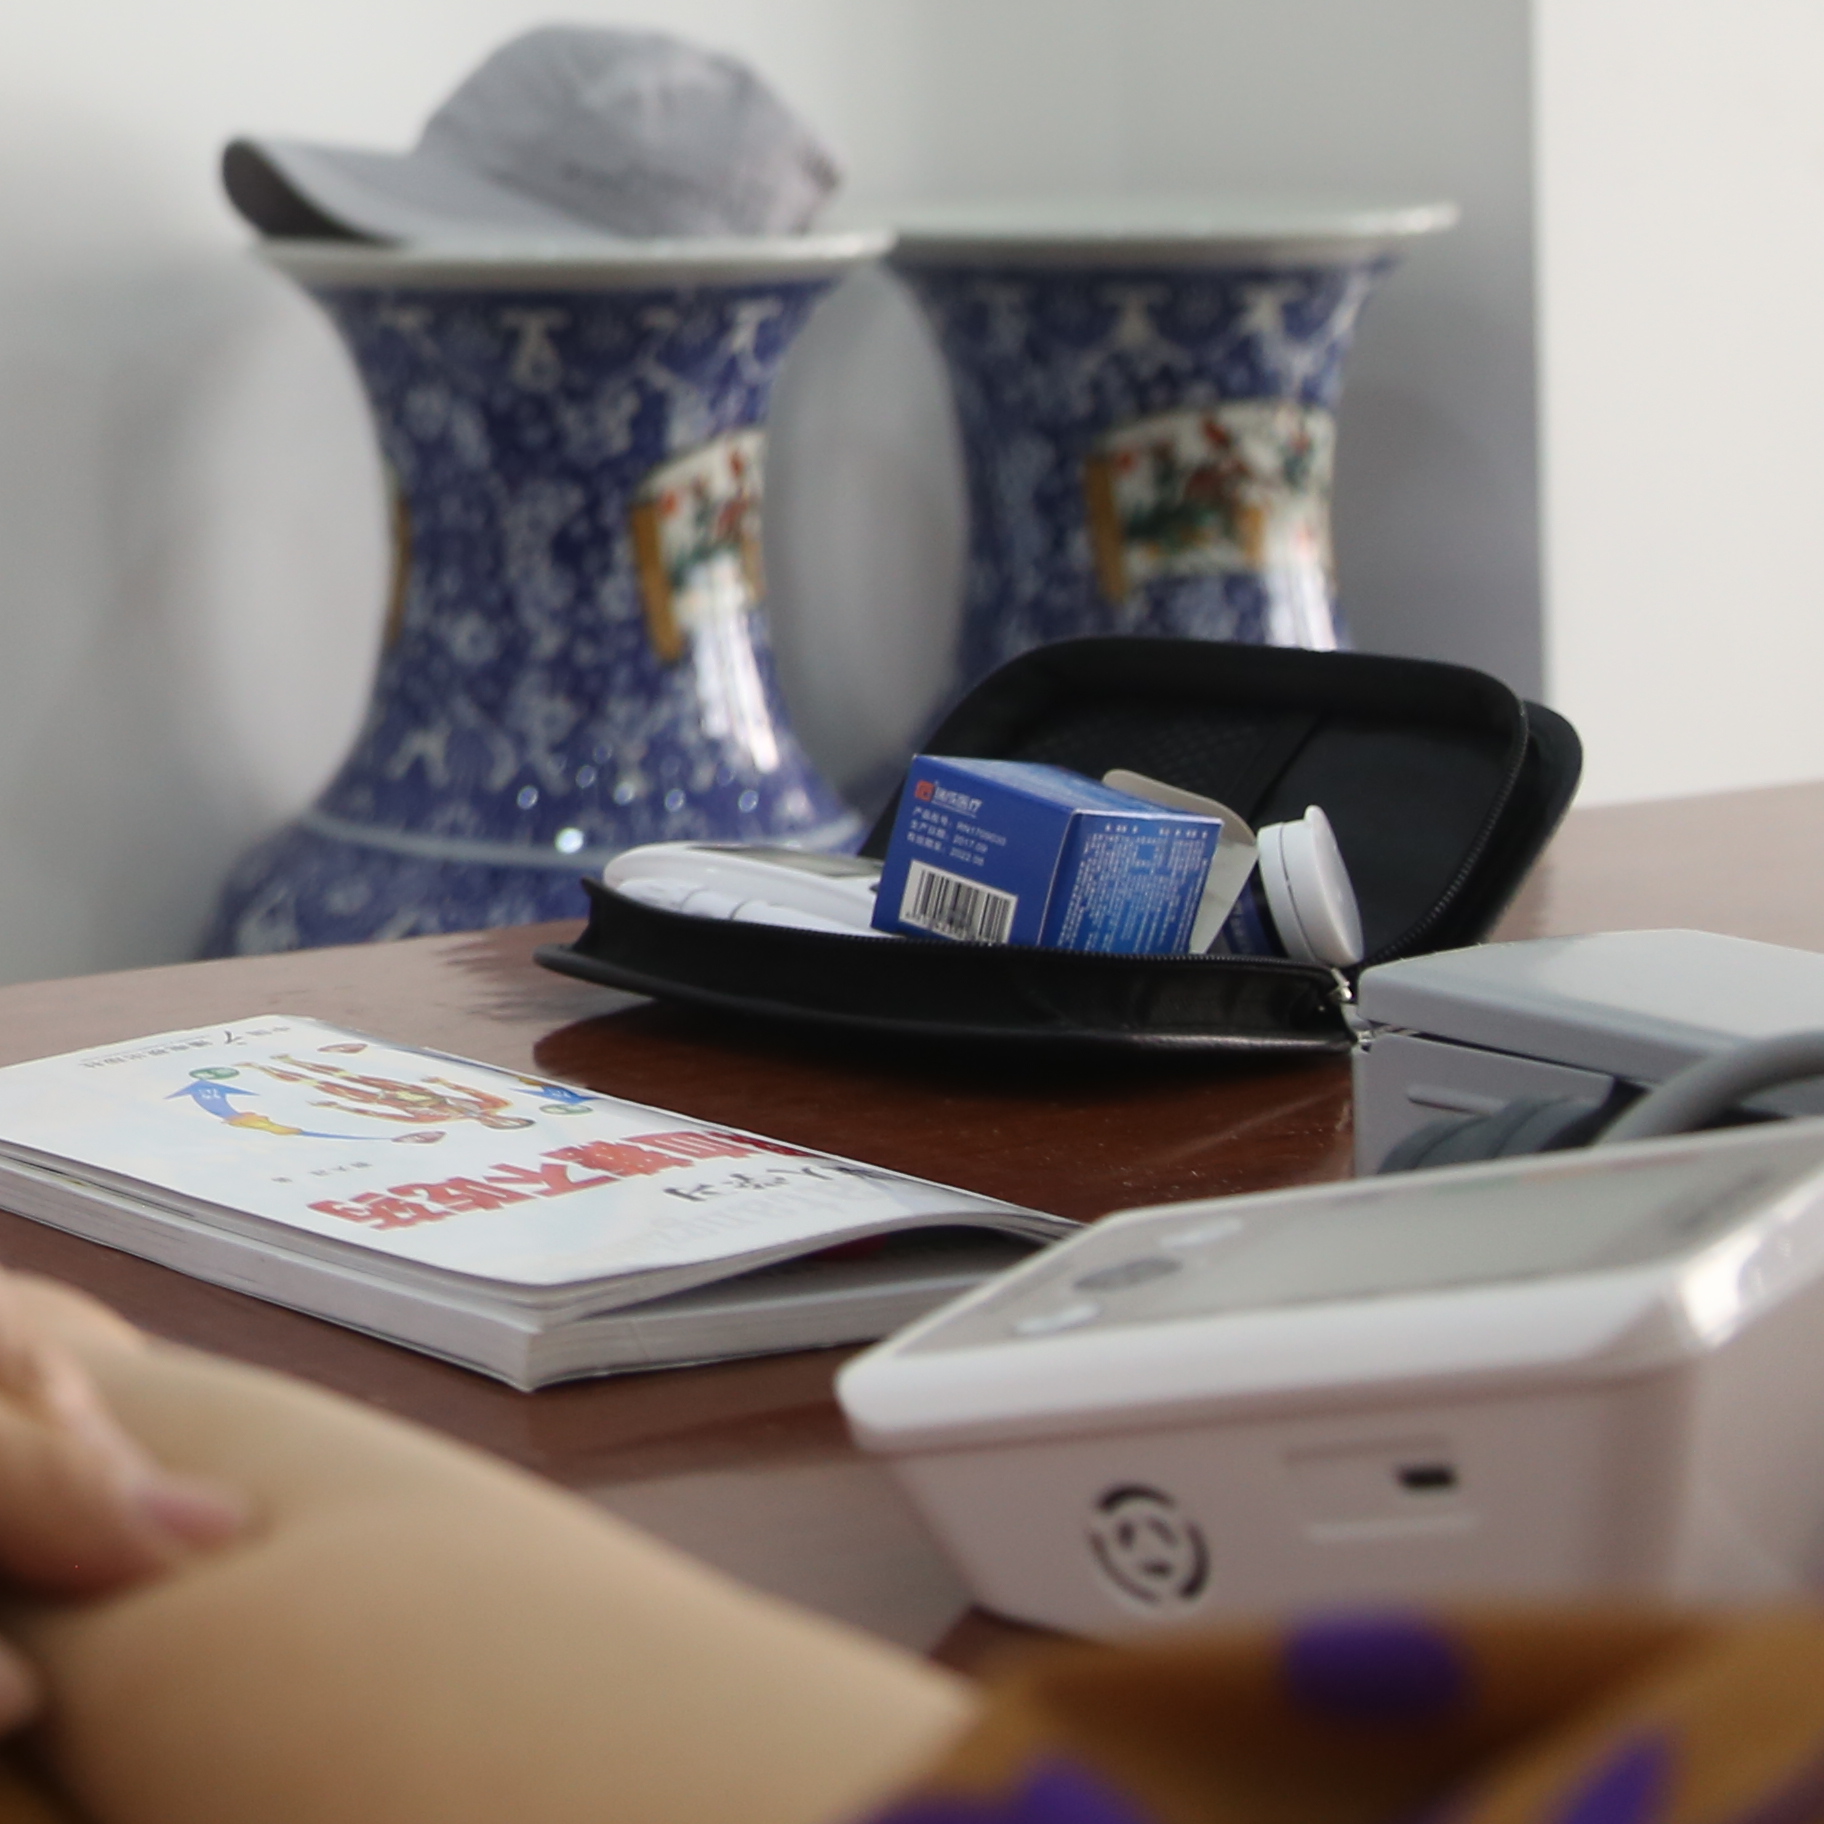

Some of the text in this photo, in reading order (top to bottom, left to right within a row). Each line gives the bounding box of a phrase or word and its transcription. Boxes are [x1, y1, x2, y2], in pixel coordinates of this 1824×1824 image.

[306, 1129, 827, 1231] 血糖不吃药
